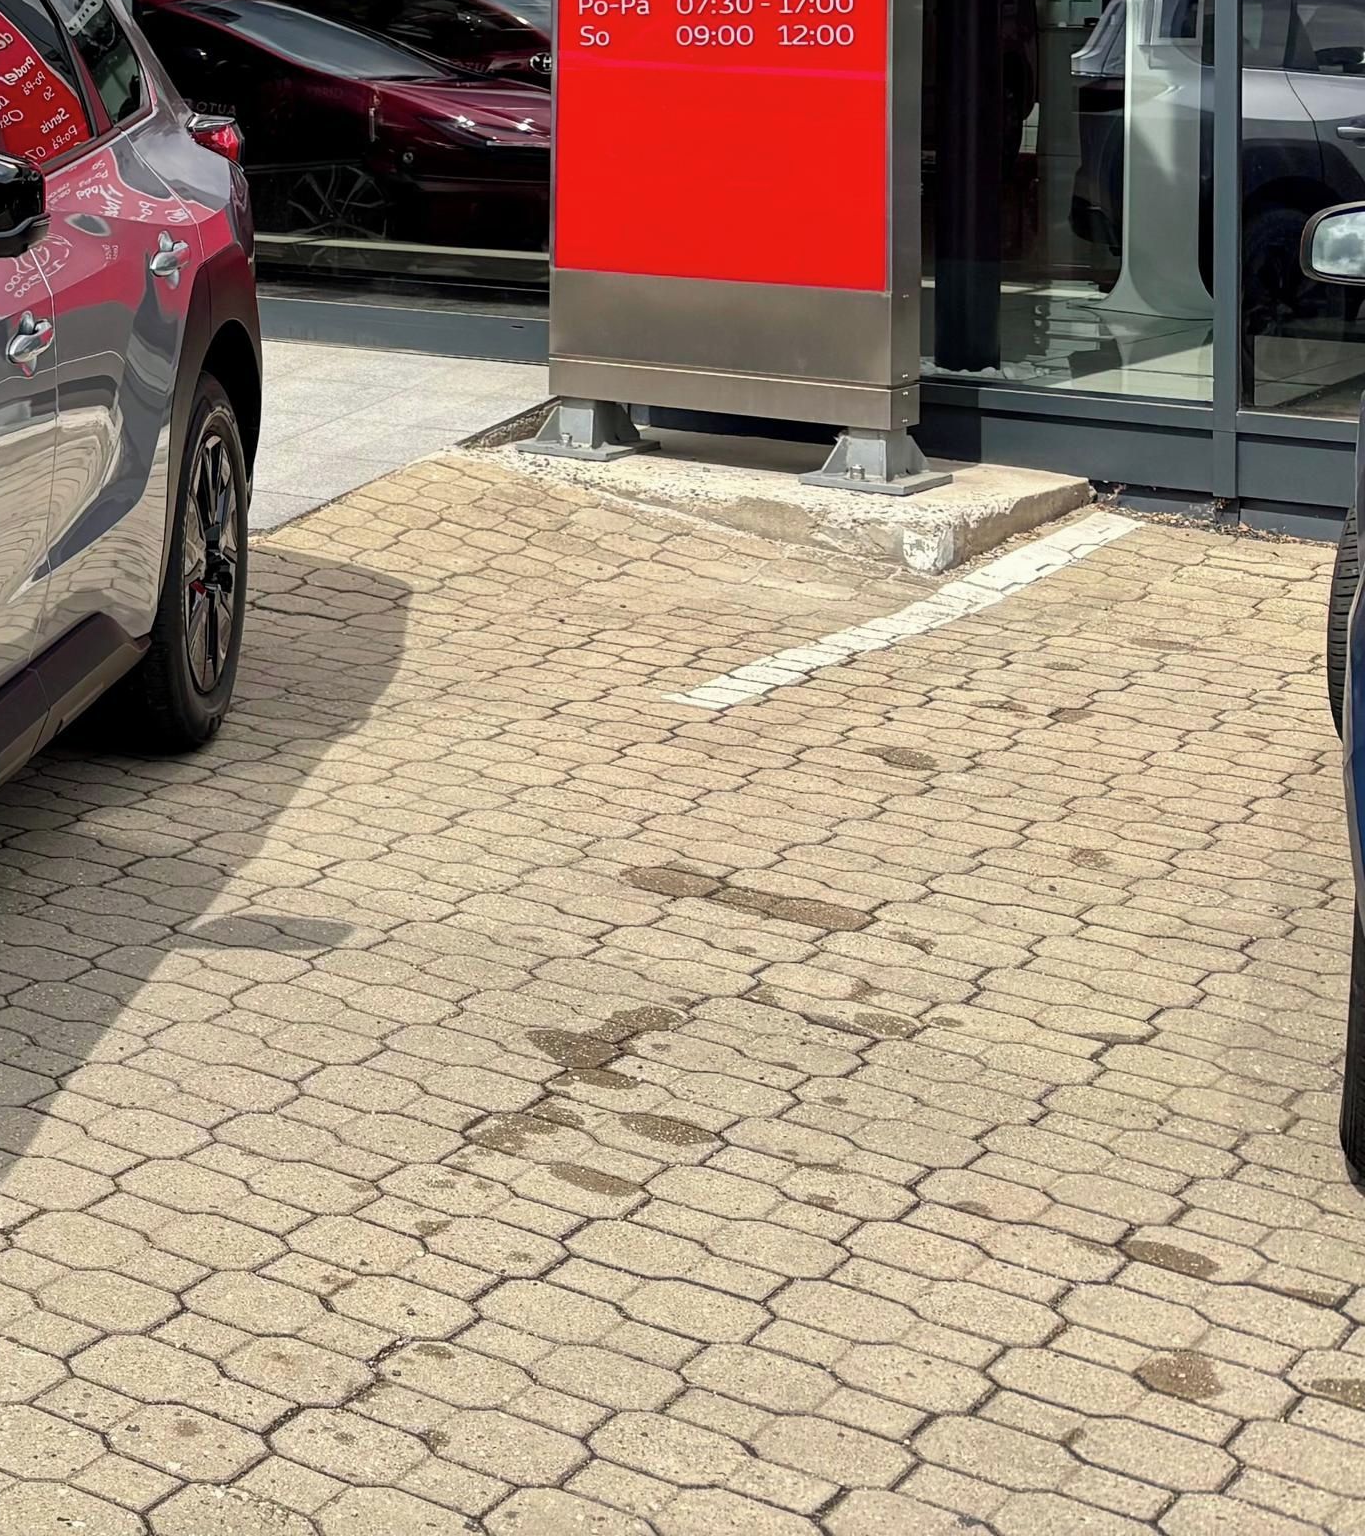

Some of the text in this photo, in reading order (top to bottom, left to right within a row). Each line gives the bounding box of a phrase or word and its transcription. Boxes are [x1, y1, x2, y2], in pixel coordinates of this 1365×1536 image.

[579, 24, 855, 47] So 09:00 12:00
